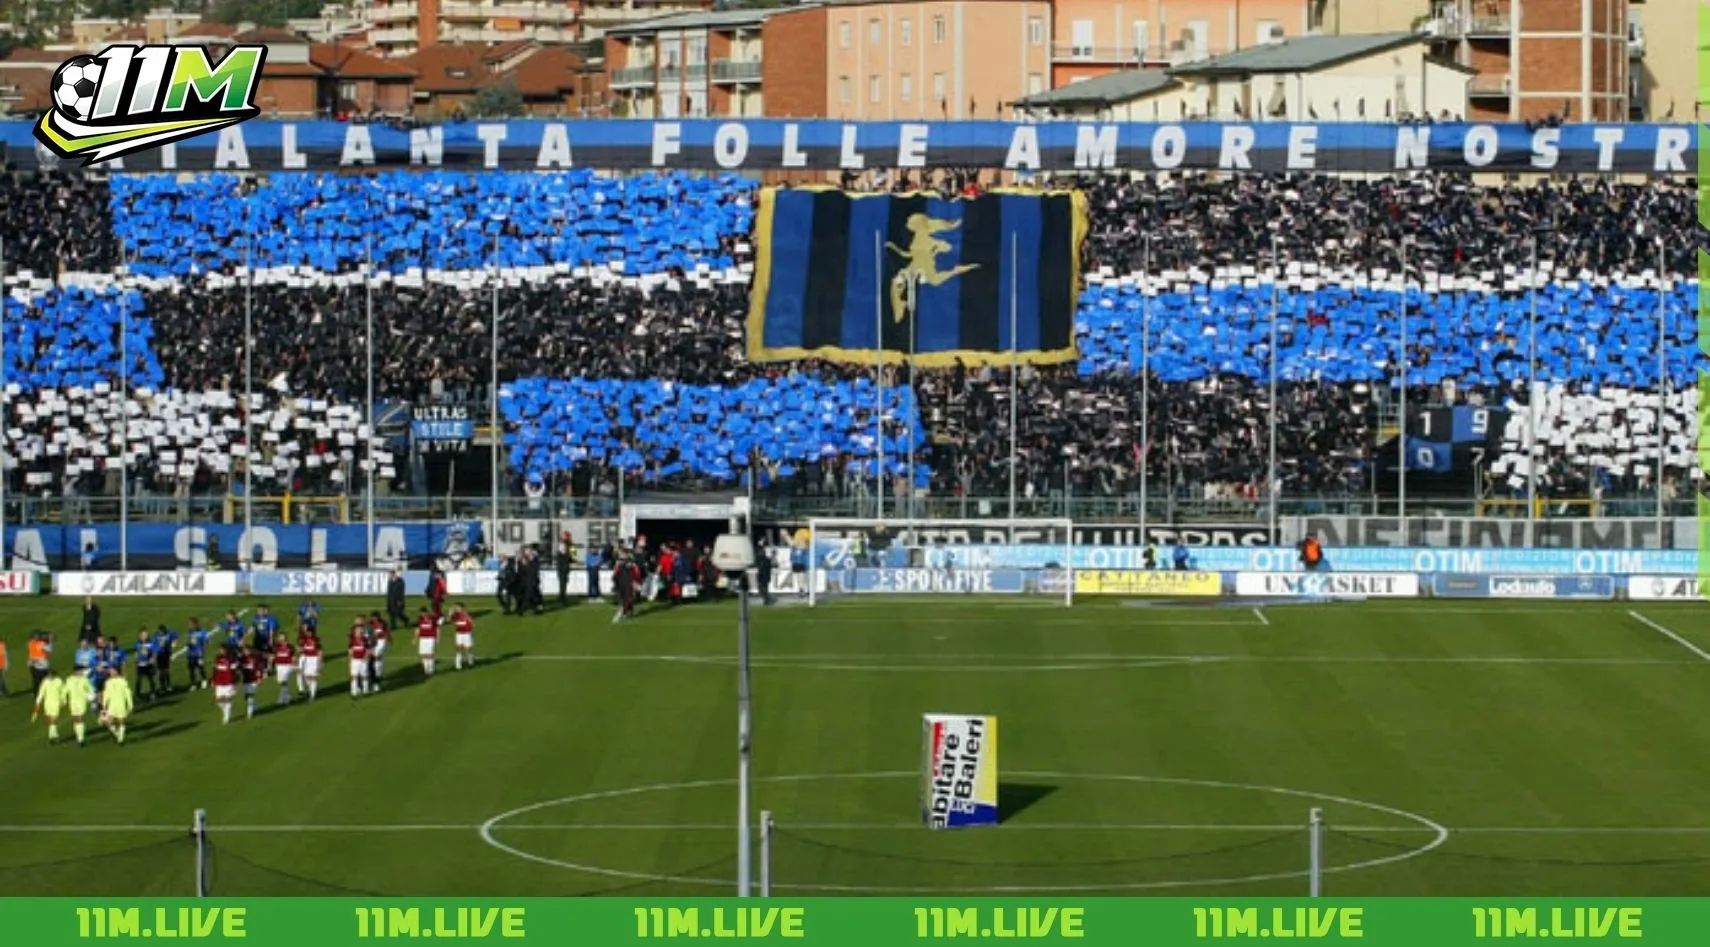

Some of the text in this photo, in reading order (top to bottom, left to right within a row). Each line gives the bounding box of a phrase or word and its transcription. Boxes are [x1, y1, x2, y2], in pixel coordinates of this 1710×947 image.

[88, 124, 572, 169] ALANTA
[651, 123, 928, 168] FOLLE
[1005, 125, 1318, 169] AMORE
[413, 406, 467, 419] ULTRAS
[174, 526, 407, 571] SOLA
[1254, 549, 1301, 571] OTI
[1414, 549, 1482, 573] OTIM
[1575, 550, 1642, 573] OTIM
[101, 574, 206, 593] ATALANTA
[303, 572, 392, 592] SPORTFIV
[954, 719, 984, 799] Baleri
